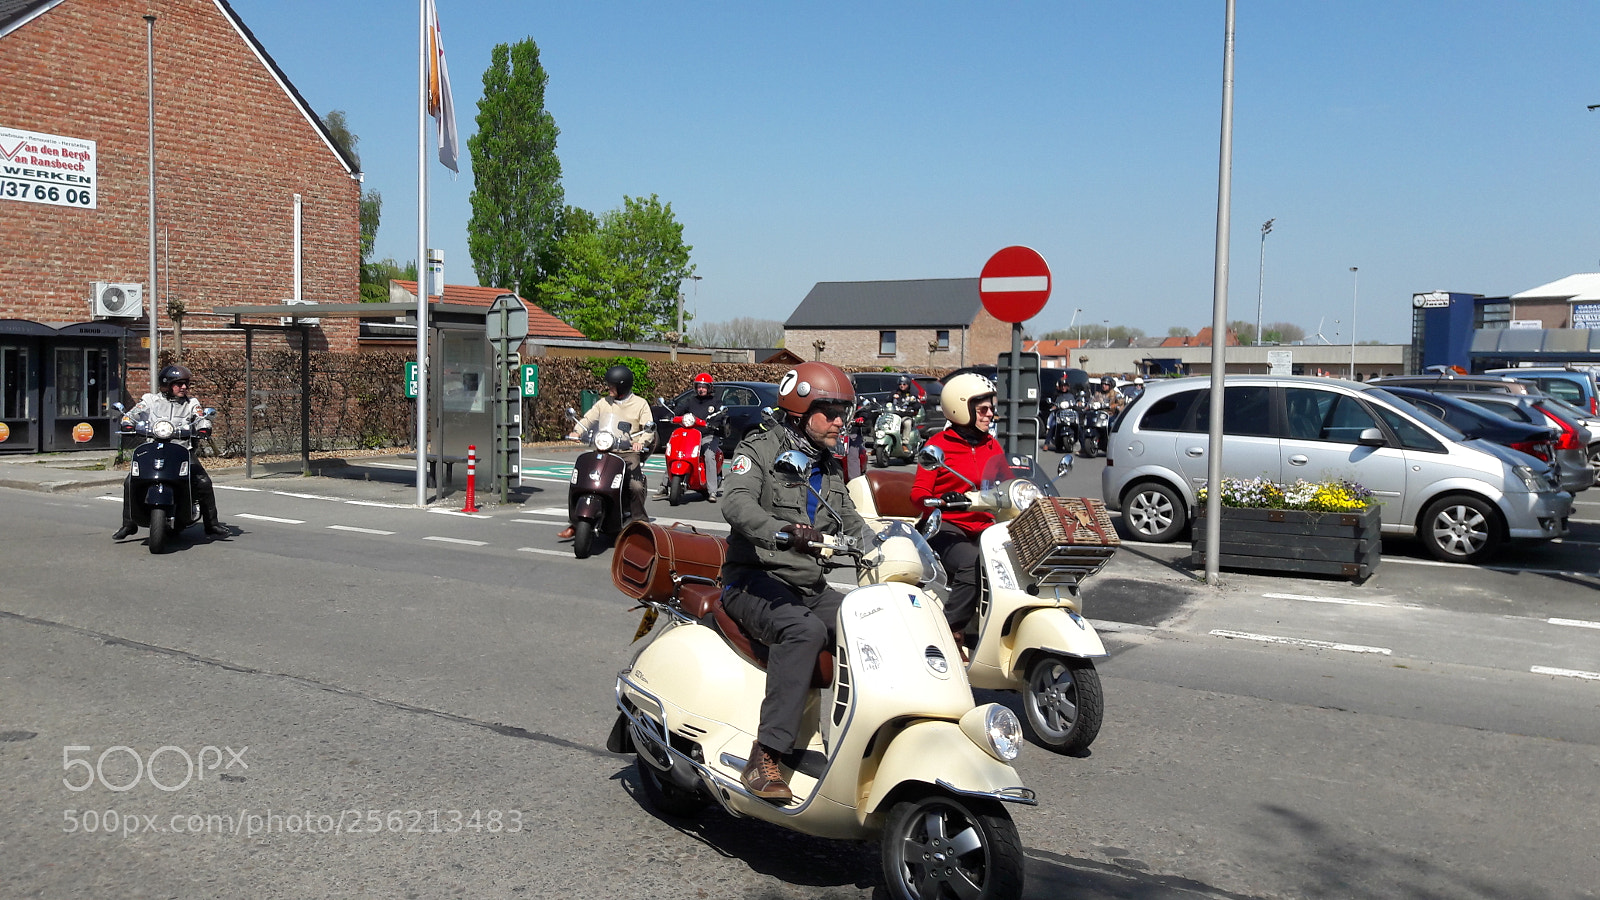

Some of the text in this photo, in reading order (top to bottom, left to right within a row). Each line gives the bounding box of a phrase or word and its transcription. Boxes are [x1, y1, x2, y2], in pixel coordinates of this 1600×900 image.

[40, 145, 59, 156] den
[61, 148, 91, 162] Bergh
[30, 155, 86, 172] Ransbeeck
[3, 166, 92, 184] WERKEN
[34, 184, 60, 202] 66
[66, 188, 91, 205] 06
[525, 367, 534, 381] P
[780, 373, 795, 392] 7
